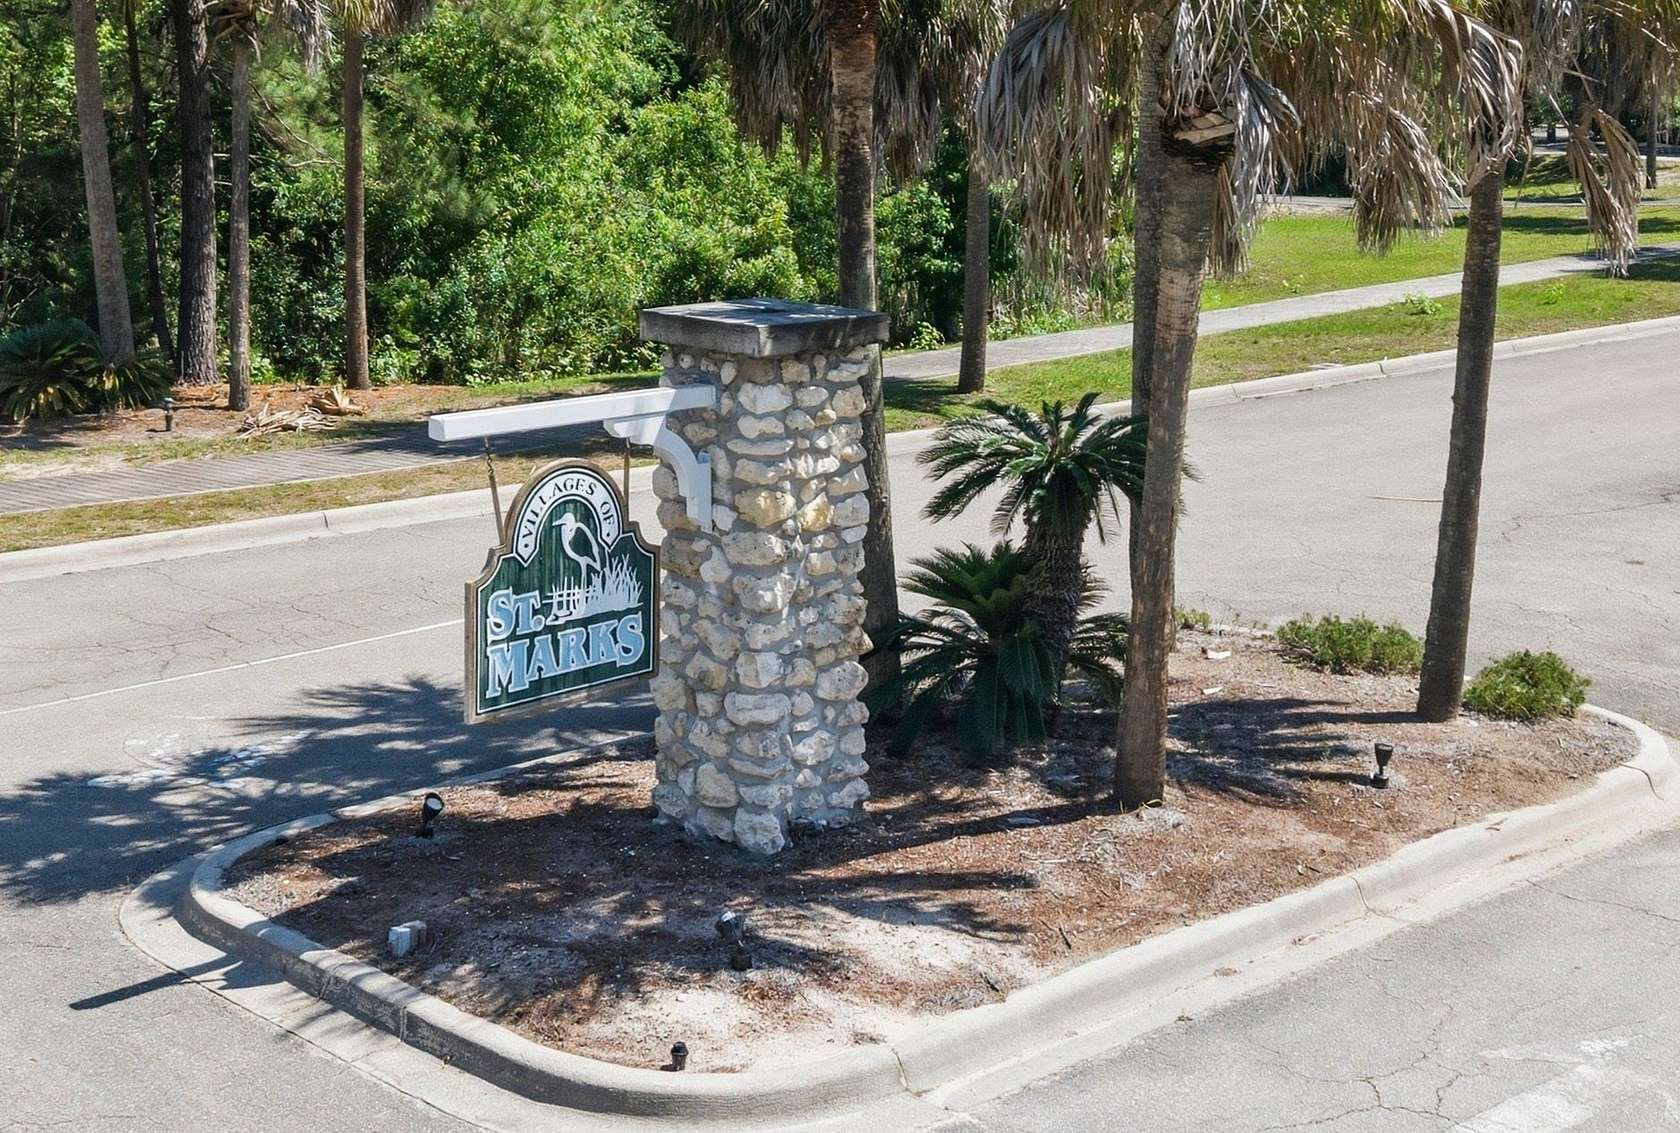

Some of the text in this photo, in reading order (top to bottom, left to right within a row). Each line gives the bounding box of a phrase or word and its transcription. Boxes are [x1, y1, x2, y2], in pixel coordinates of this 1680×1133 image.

[523, 478, 615, 539] VILLAGES OF
[487, 587, 545, 644] ST.
[486, 611, 645, 698] MARKS
